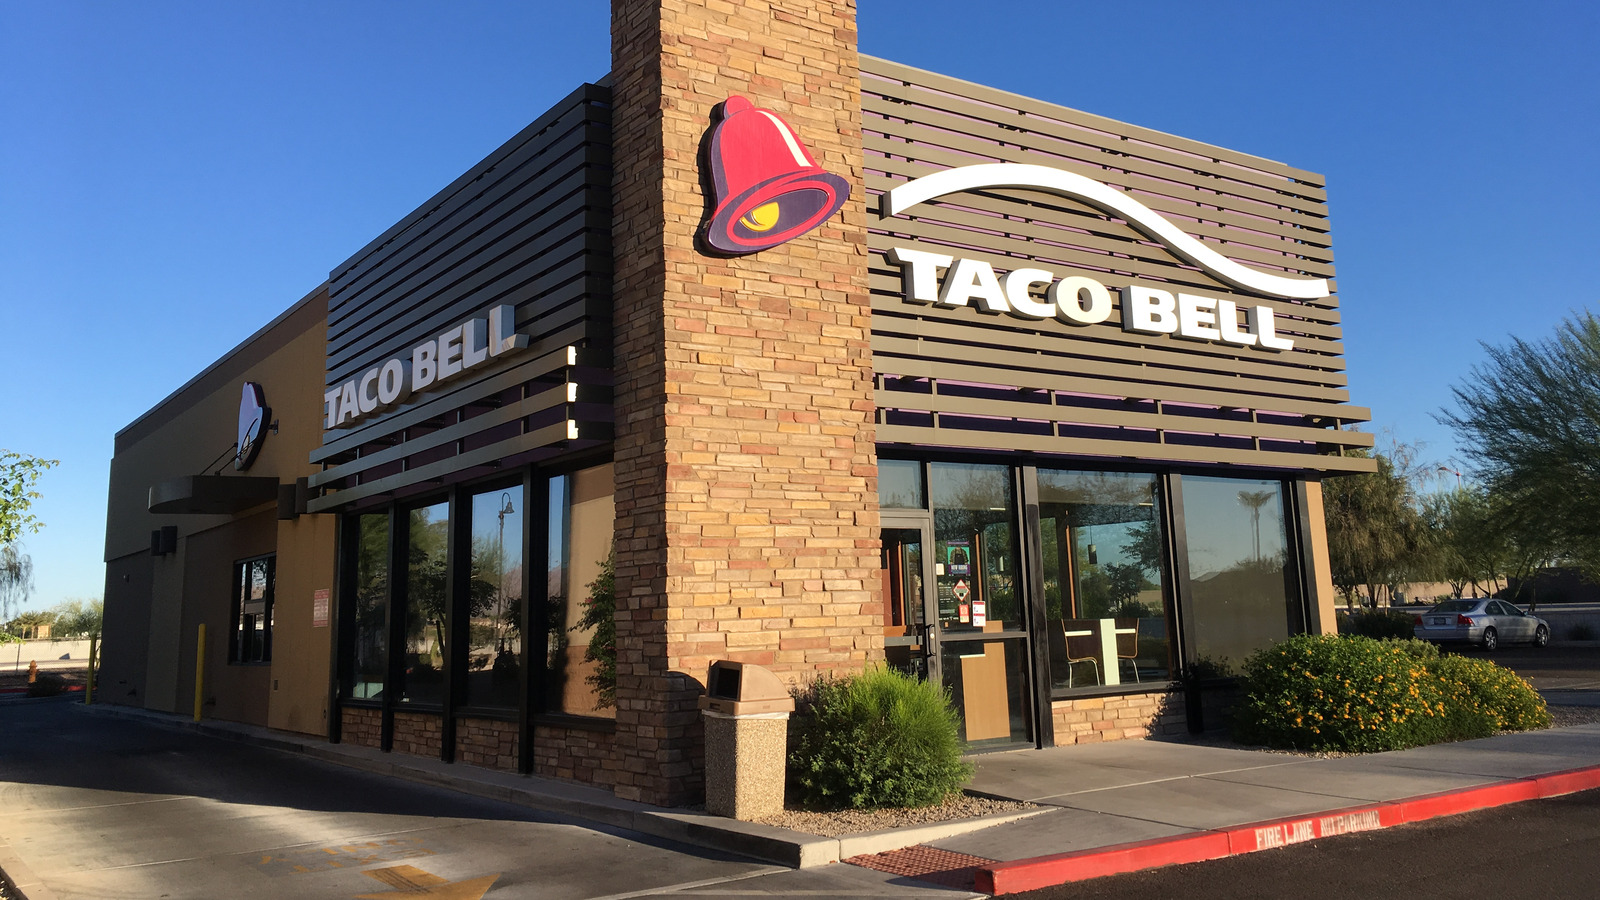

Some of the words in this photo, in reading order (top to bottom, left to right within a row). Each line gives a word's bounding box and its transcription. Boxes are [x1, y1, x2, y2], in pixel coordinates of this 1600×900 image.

[890, 247, 1113, 325] TACO
[1121, 285, 1294, 352] BELL
[324, 358, 407, 429] TACO
[412, 304, 529, 392] BELL
[1255, 826, 1283, 850] FIRE
[1284, 820, 1315, 845] LANE
[1338, 810, 1381, 834] PARKING
